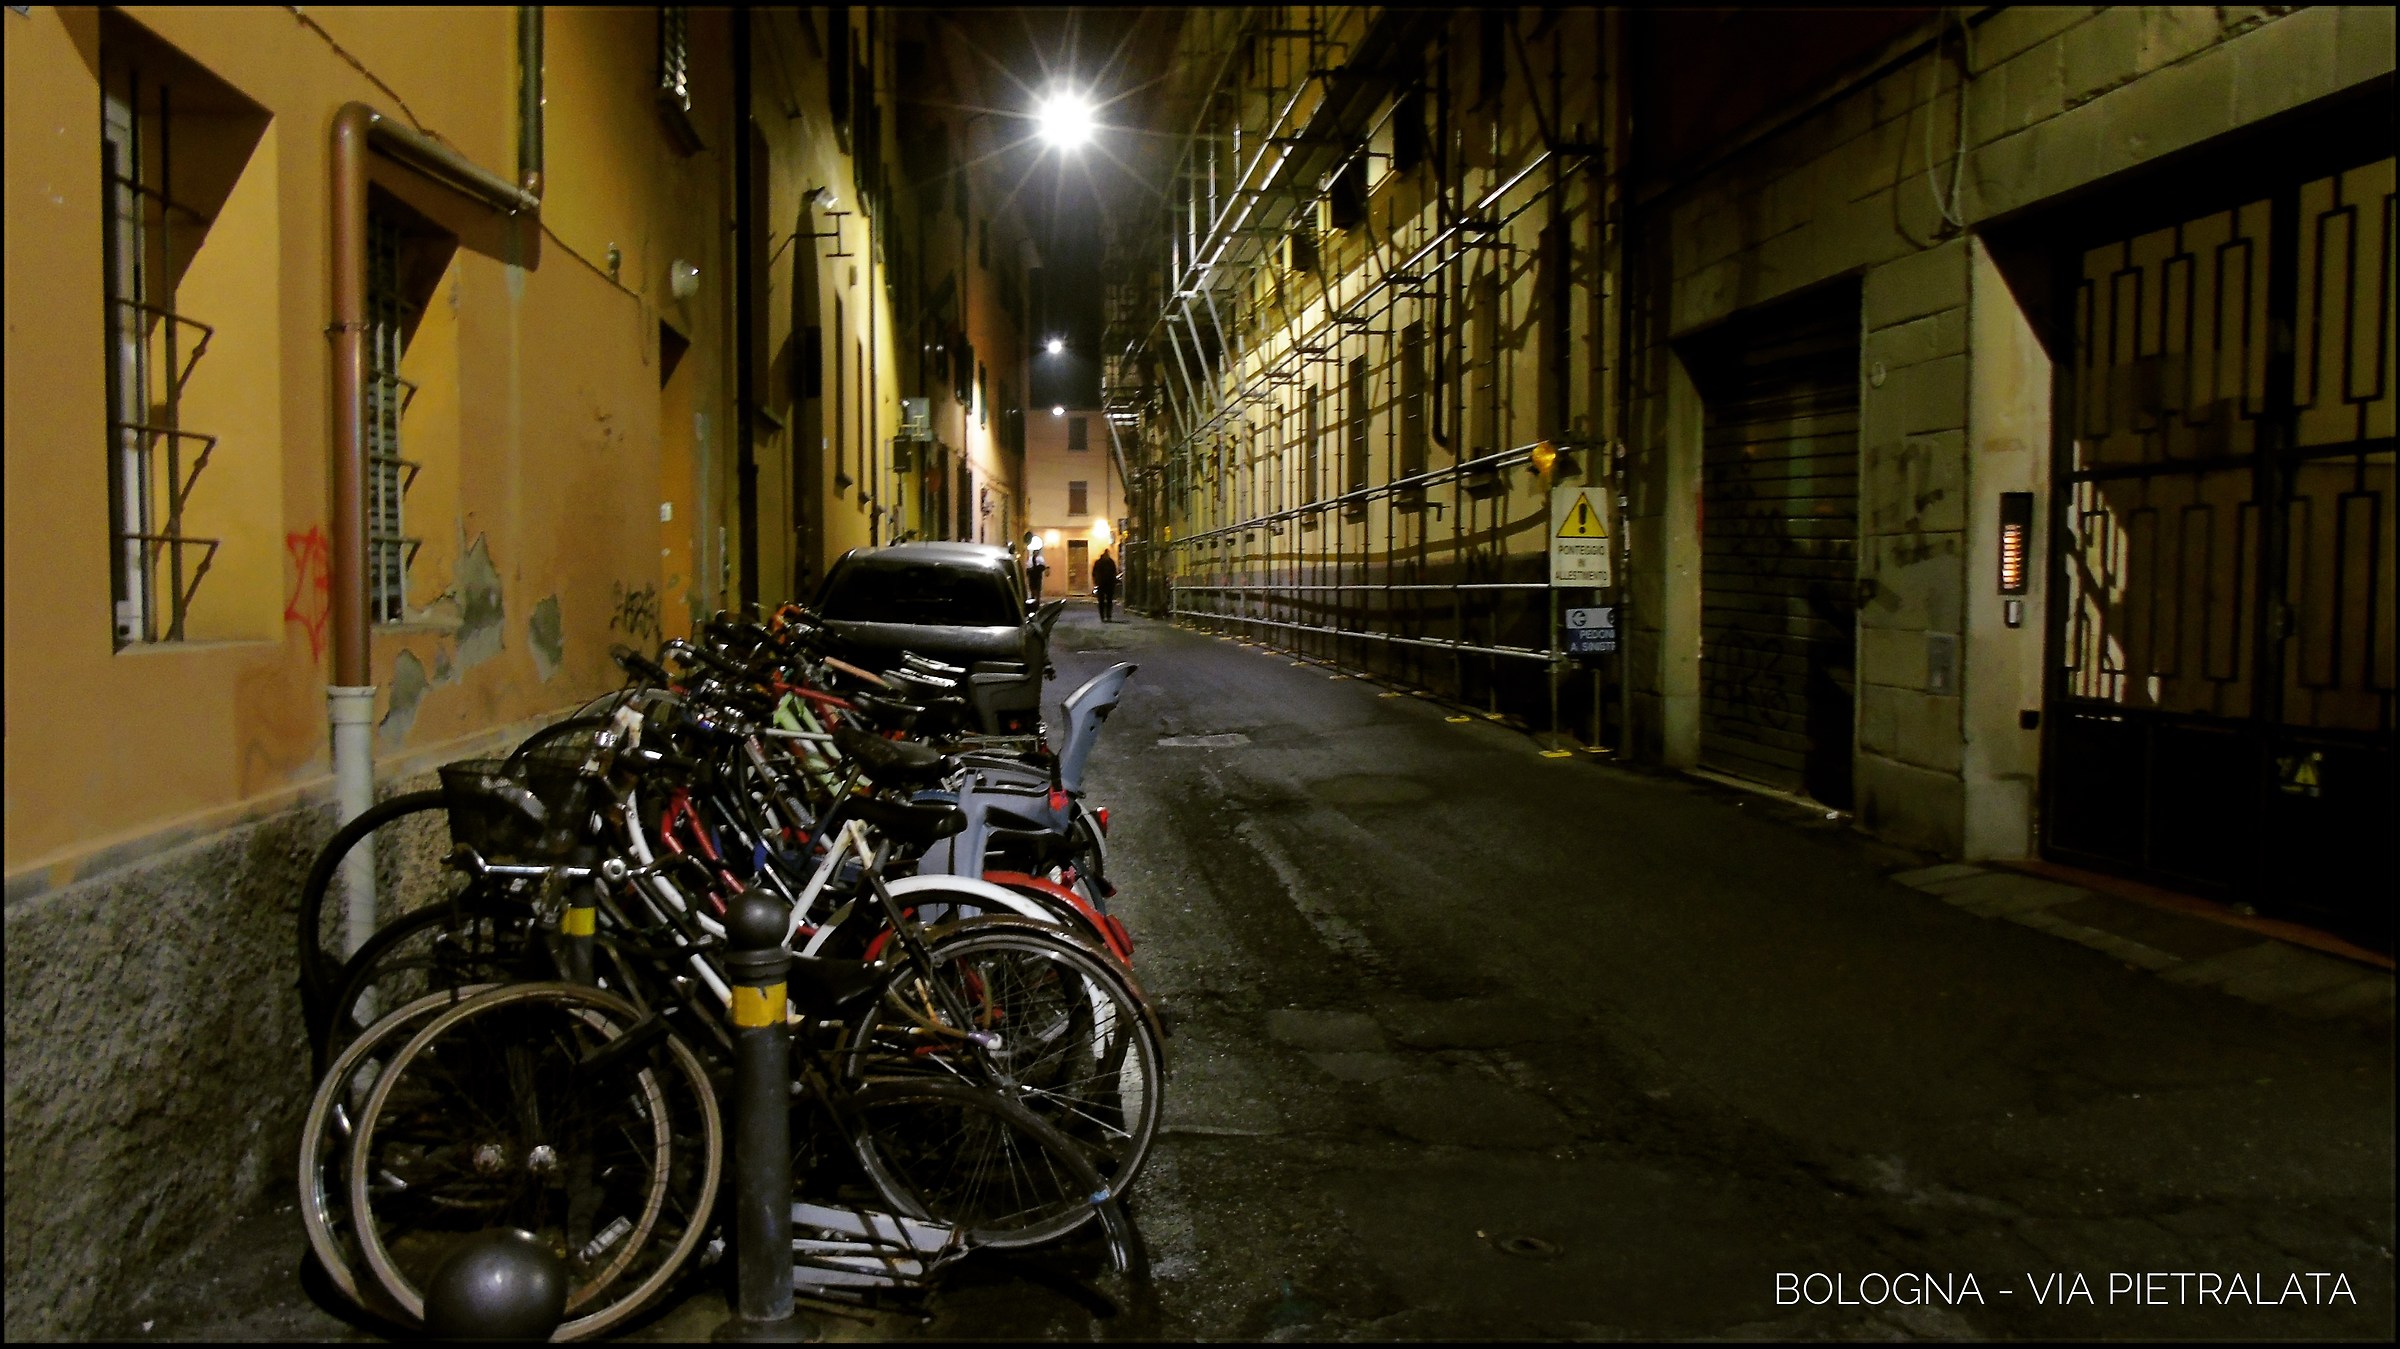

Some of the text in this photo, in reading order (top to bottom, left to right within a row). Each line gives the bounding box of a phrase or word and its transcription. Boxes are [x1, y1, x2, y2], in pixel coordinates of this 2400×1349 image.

[1558, 545, 1605, 555] PONTEGGIO
[1555, 570, 1607, 581] ALLESTIMENTO
[1569, 641, 1578, 651] A
